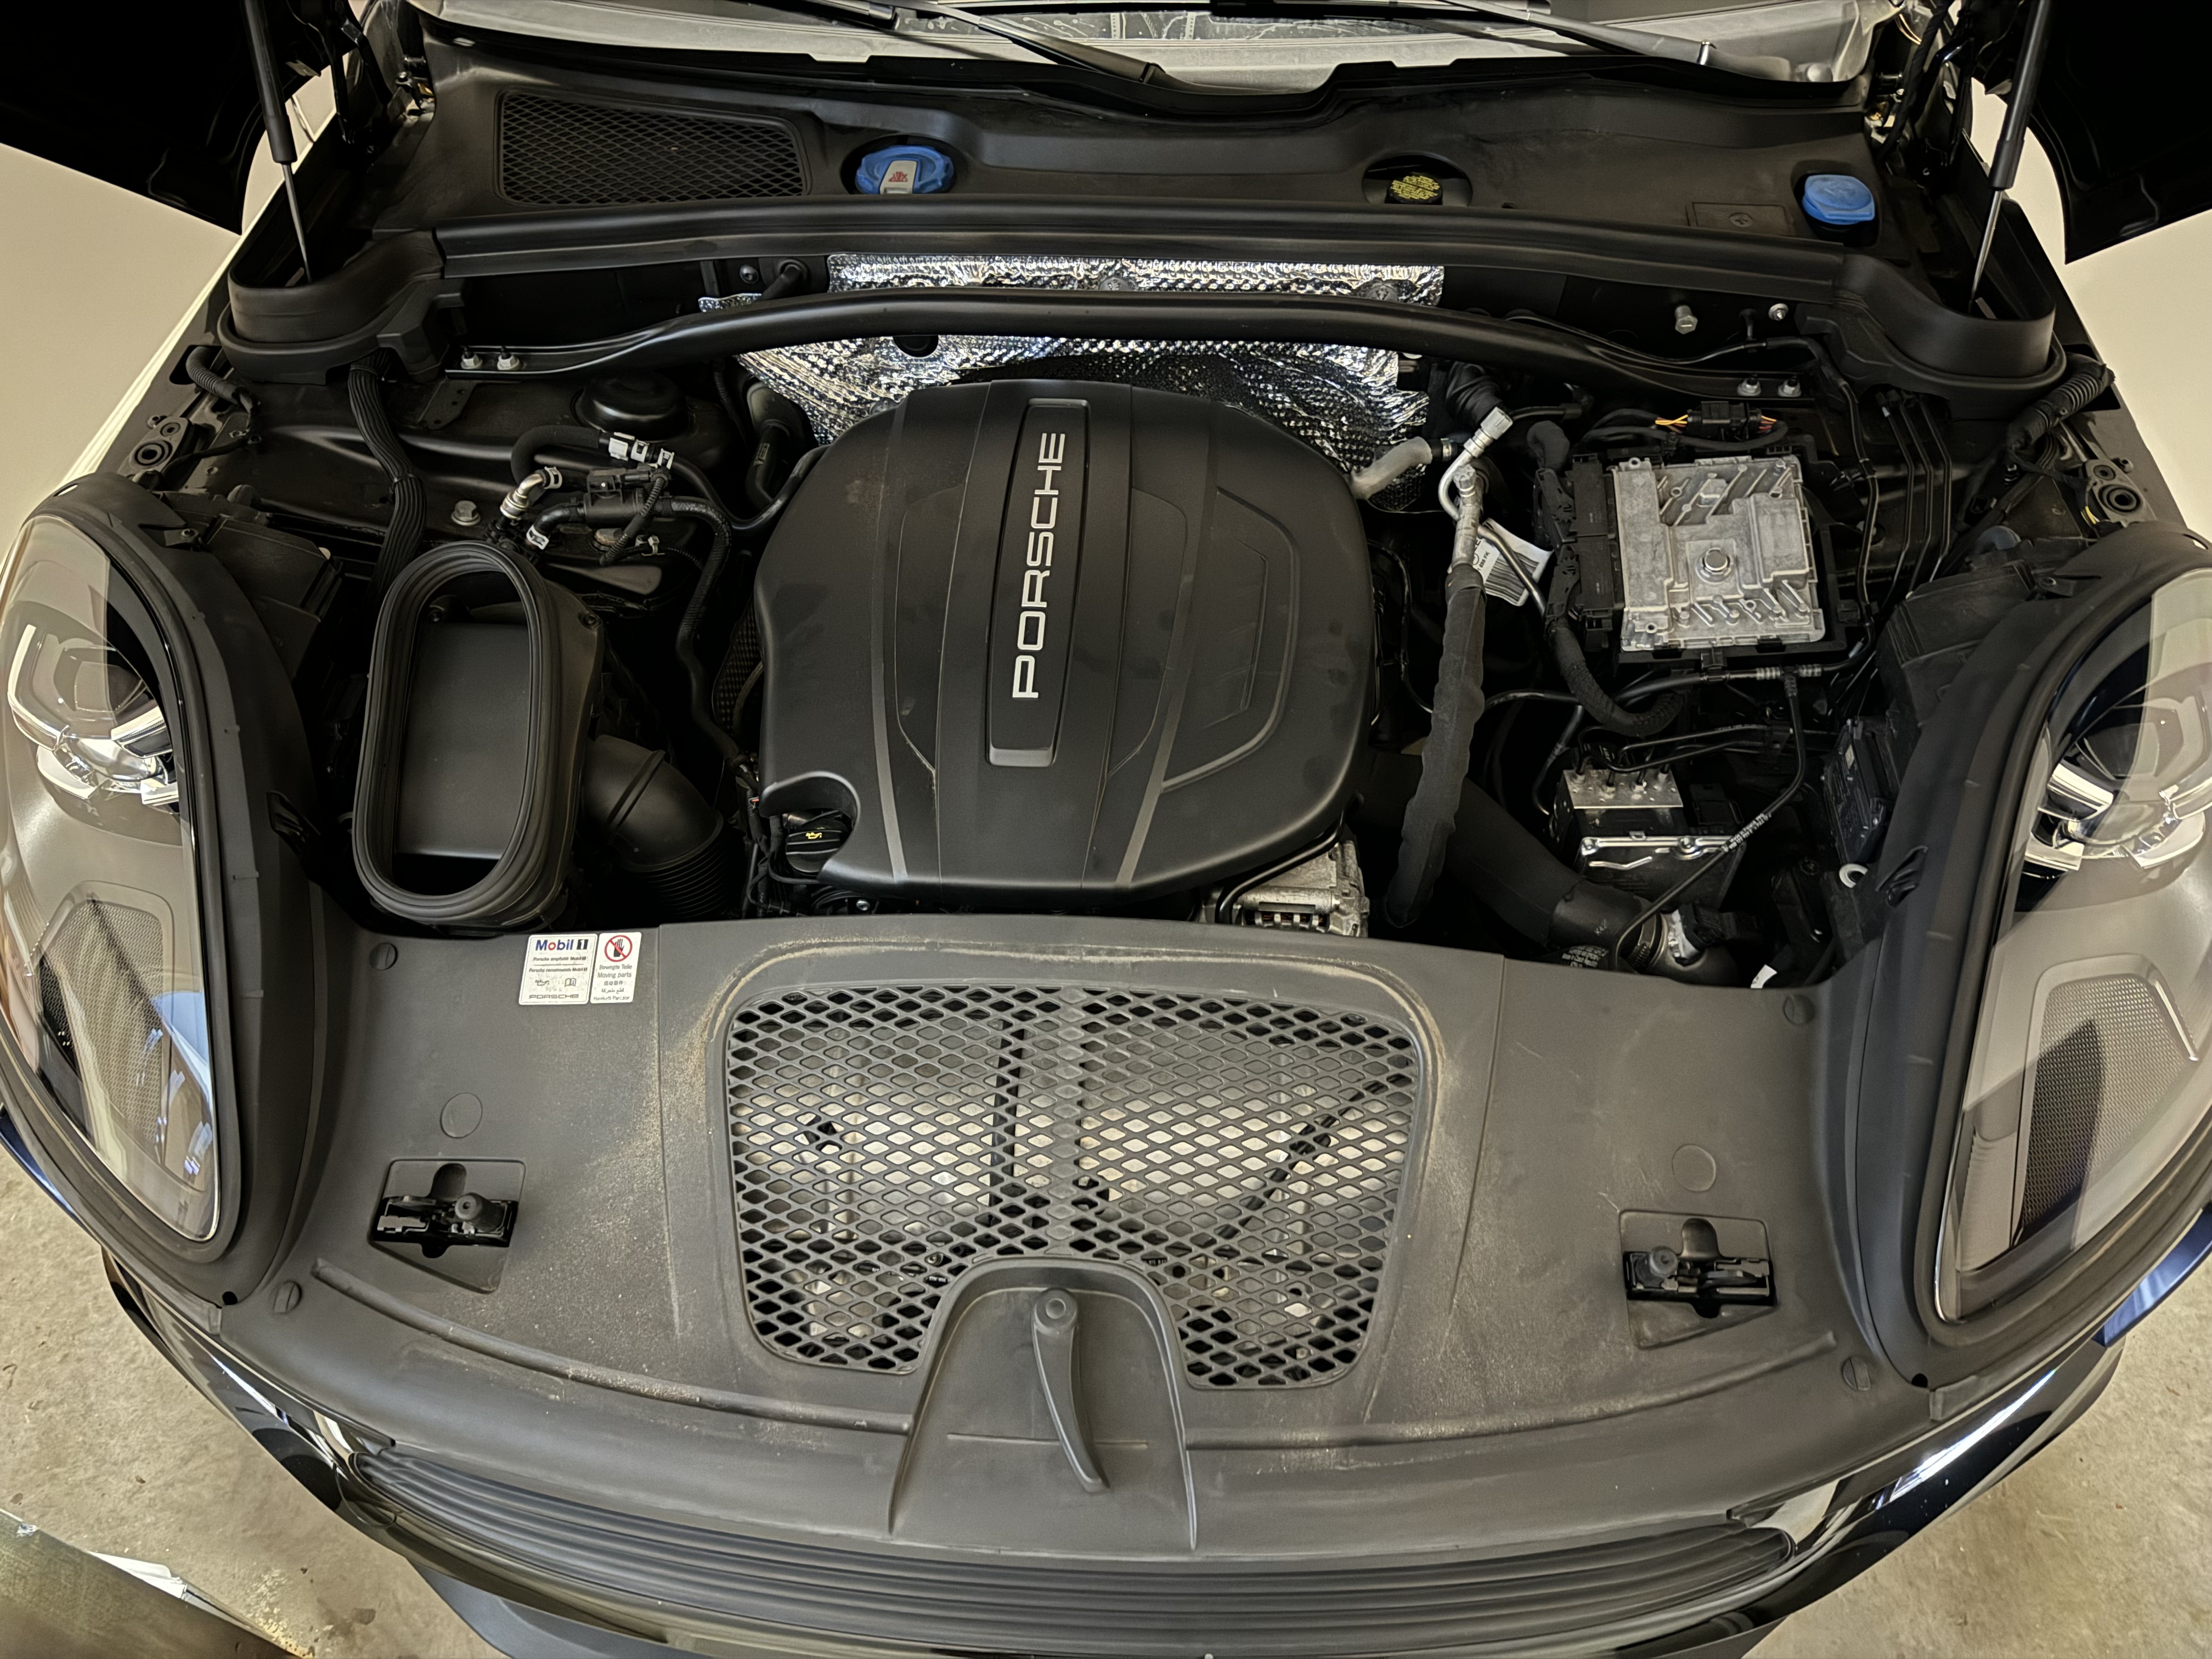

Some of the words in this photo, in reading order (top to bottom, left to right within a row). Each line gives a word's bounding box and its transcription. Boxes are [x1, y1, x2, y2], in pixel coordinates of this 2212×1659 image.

[1012, 433, 1065, 698] PORSCHE
[535, 939, 574, 951] Mobil
[577, 939, 588, 950] 1
